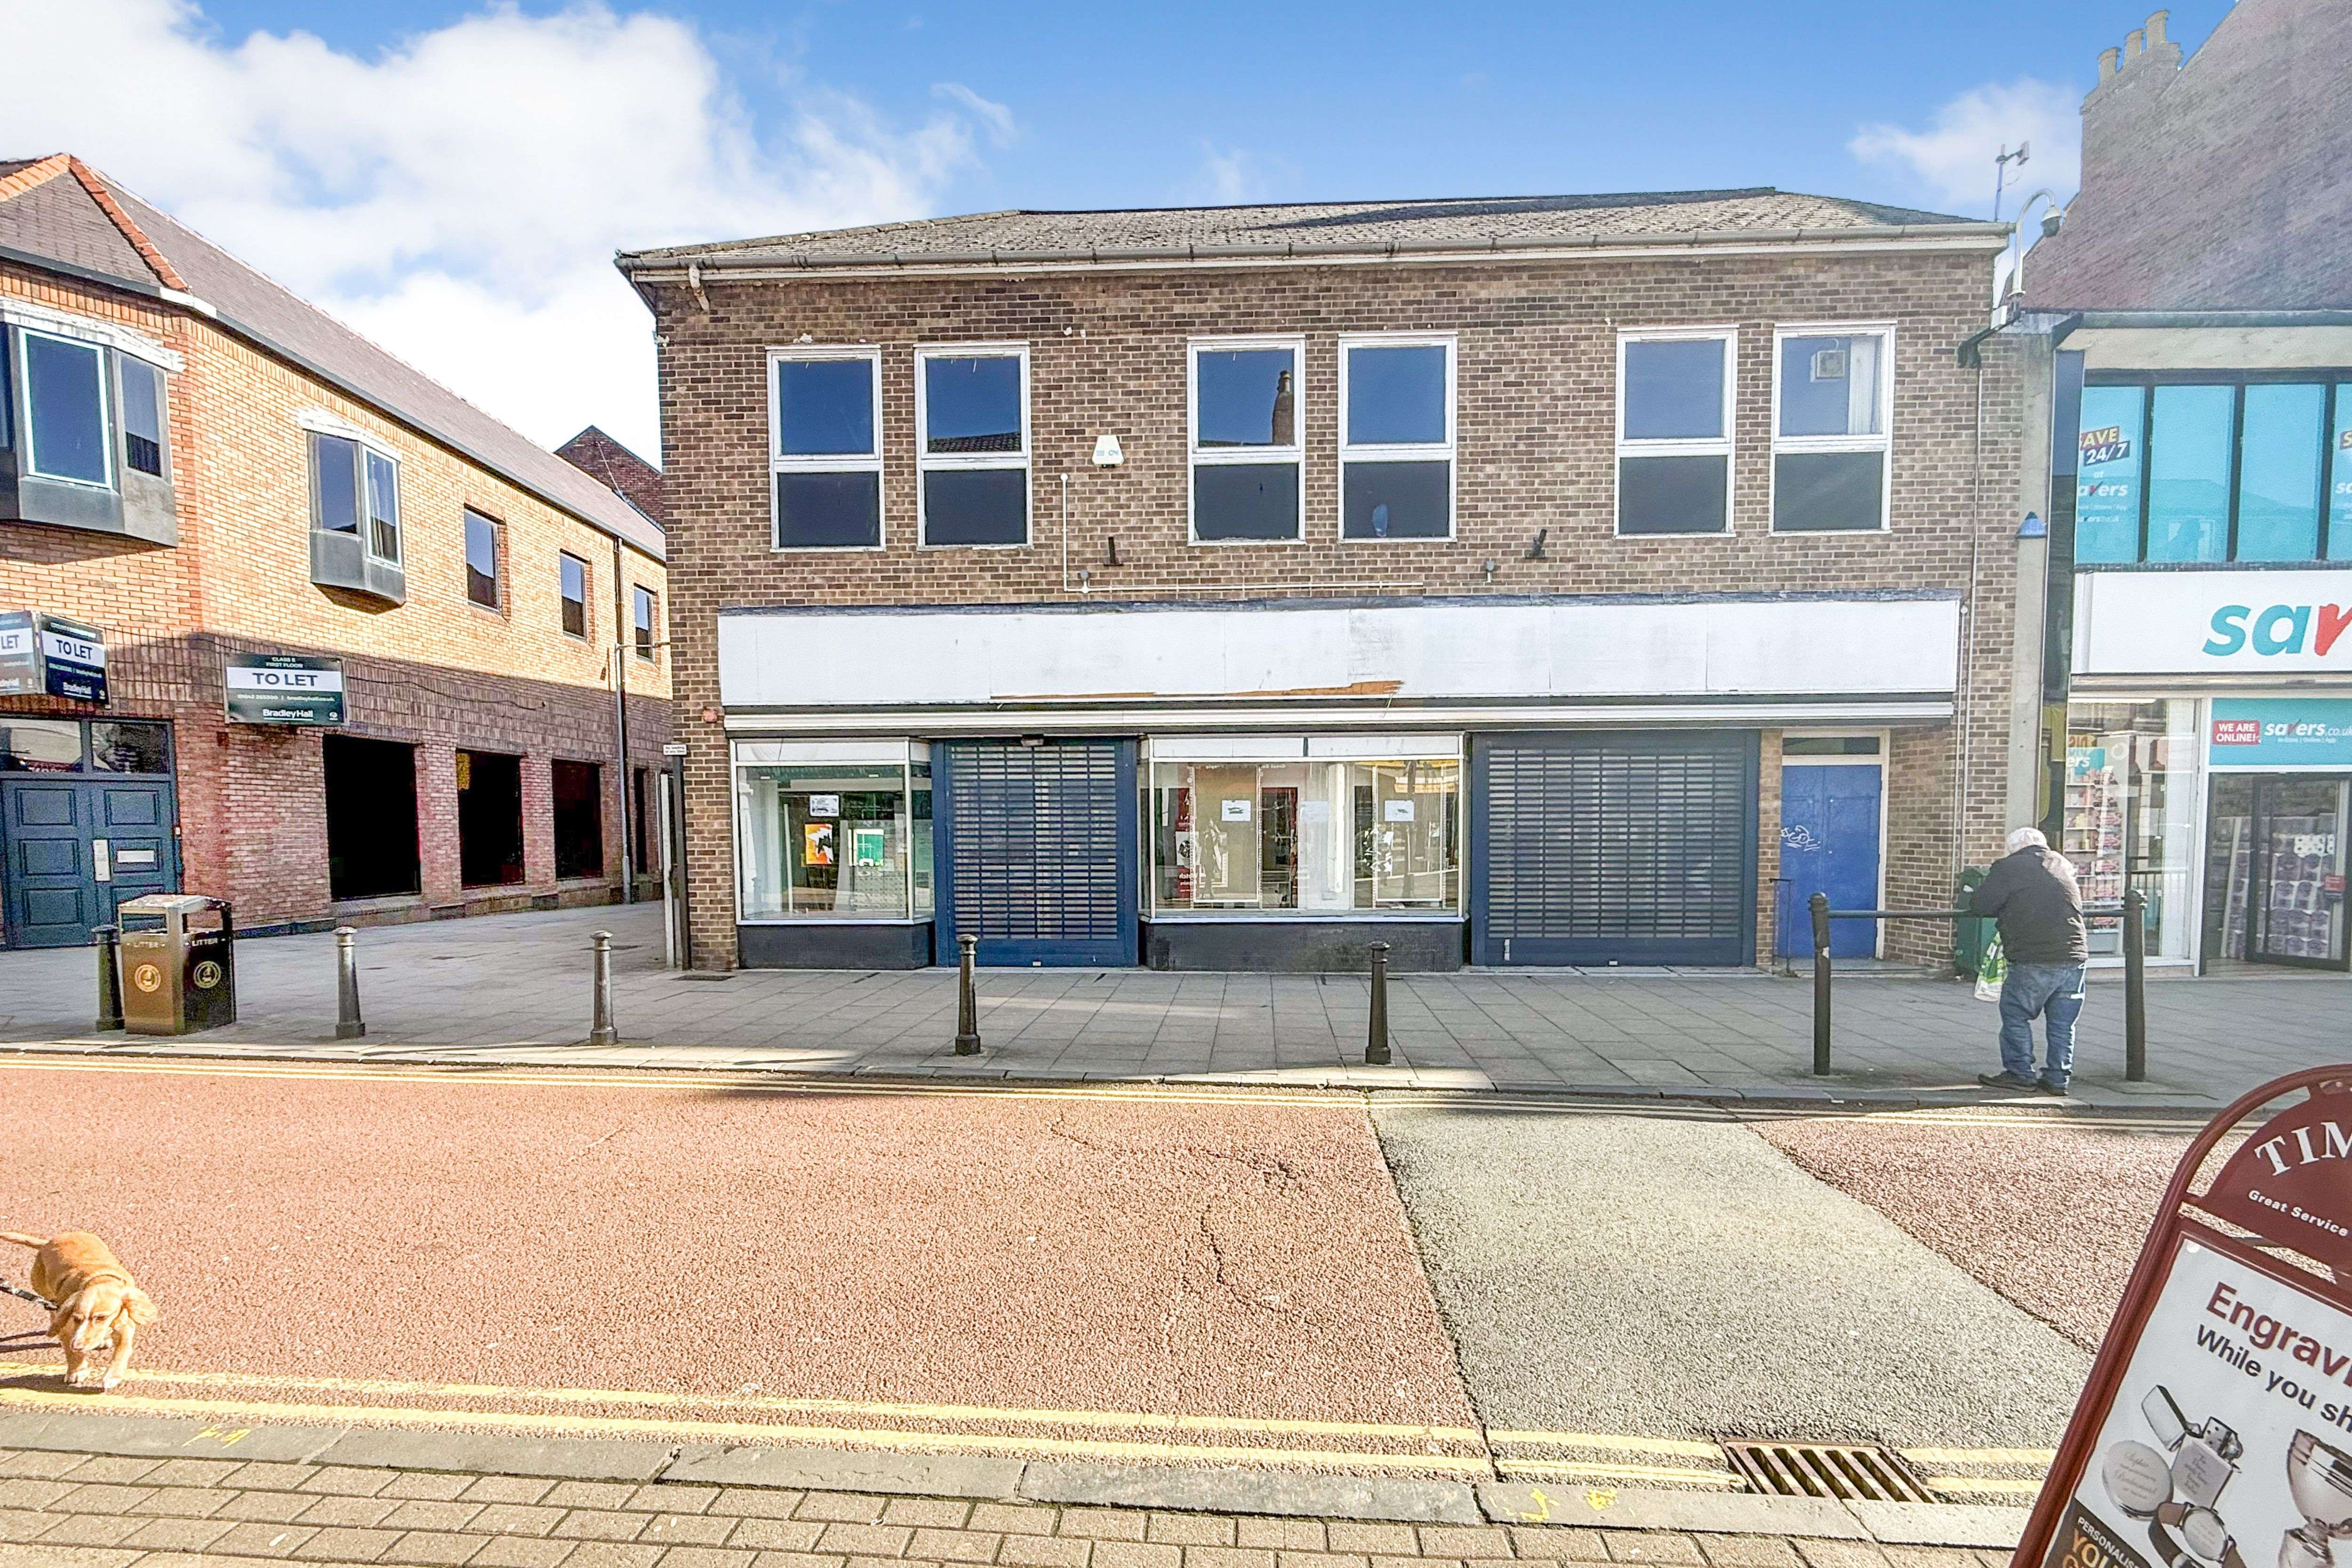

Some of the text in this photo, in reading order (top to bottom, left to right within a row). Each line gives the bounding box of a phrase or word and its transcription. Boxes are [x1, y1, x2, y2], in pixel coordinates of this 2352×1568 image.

[2081, 428, 2118, 447] AVE
[2086, 442, 2128, 464] 24/7
[2079, 481, 2129, 496] avers
[1, 635, 19, 650] LET
[56, 639, 93, 660] TO LET
[252, 672, 318, 686] TO LET
[2218, 723, 2255, 732] WE ARE
[2216, 733, 2256, 742] ONLINE!
[191, 938, 218, 947] LITTER
[2254, 1122, 2352, 1176] TIM
[2249, 1189, 2349, 1237] Great Service
[2197, 1324, 2352, 1433] While you sh
